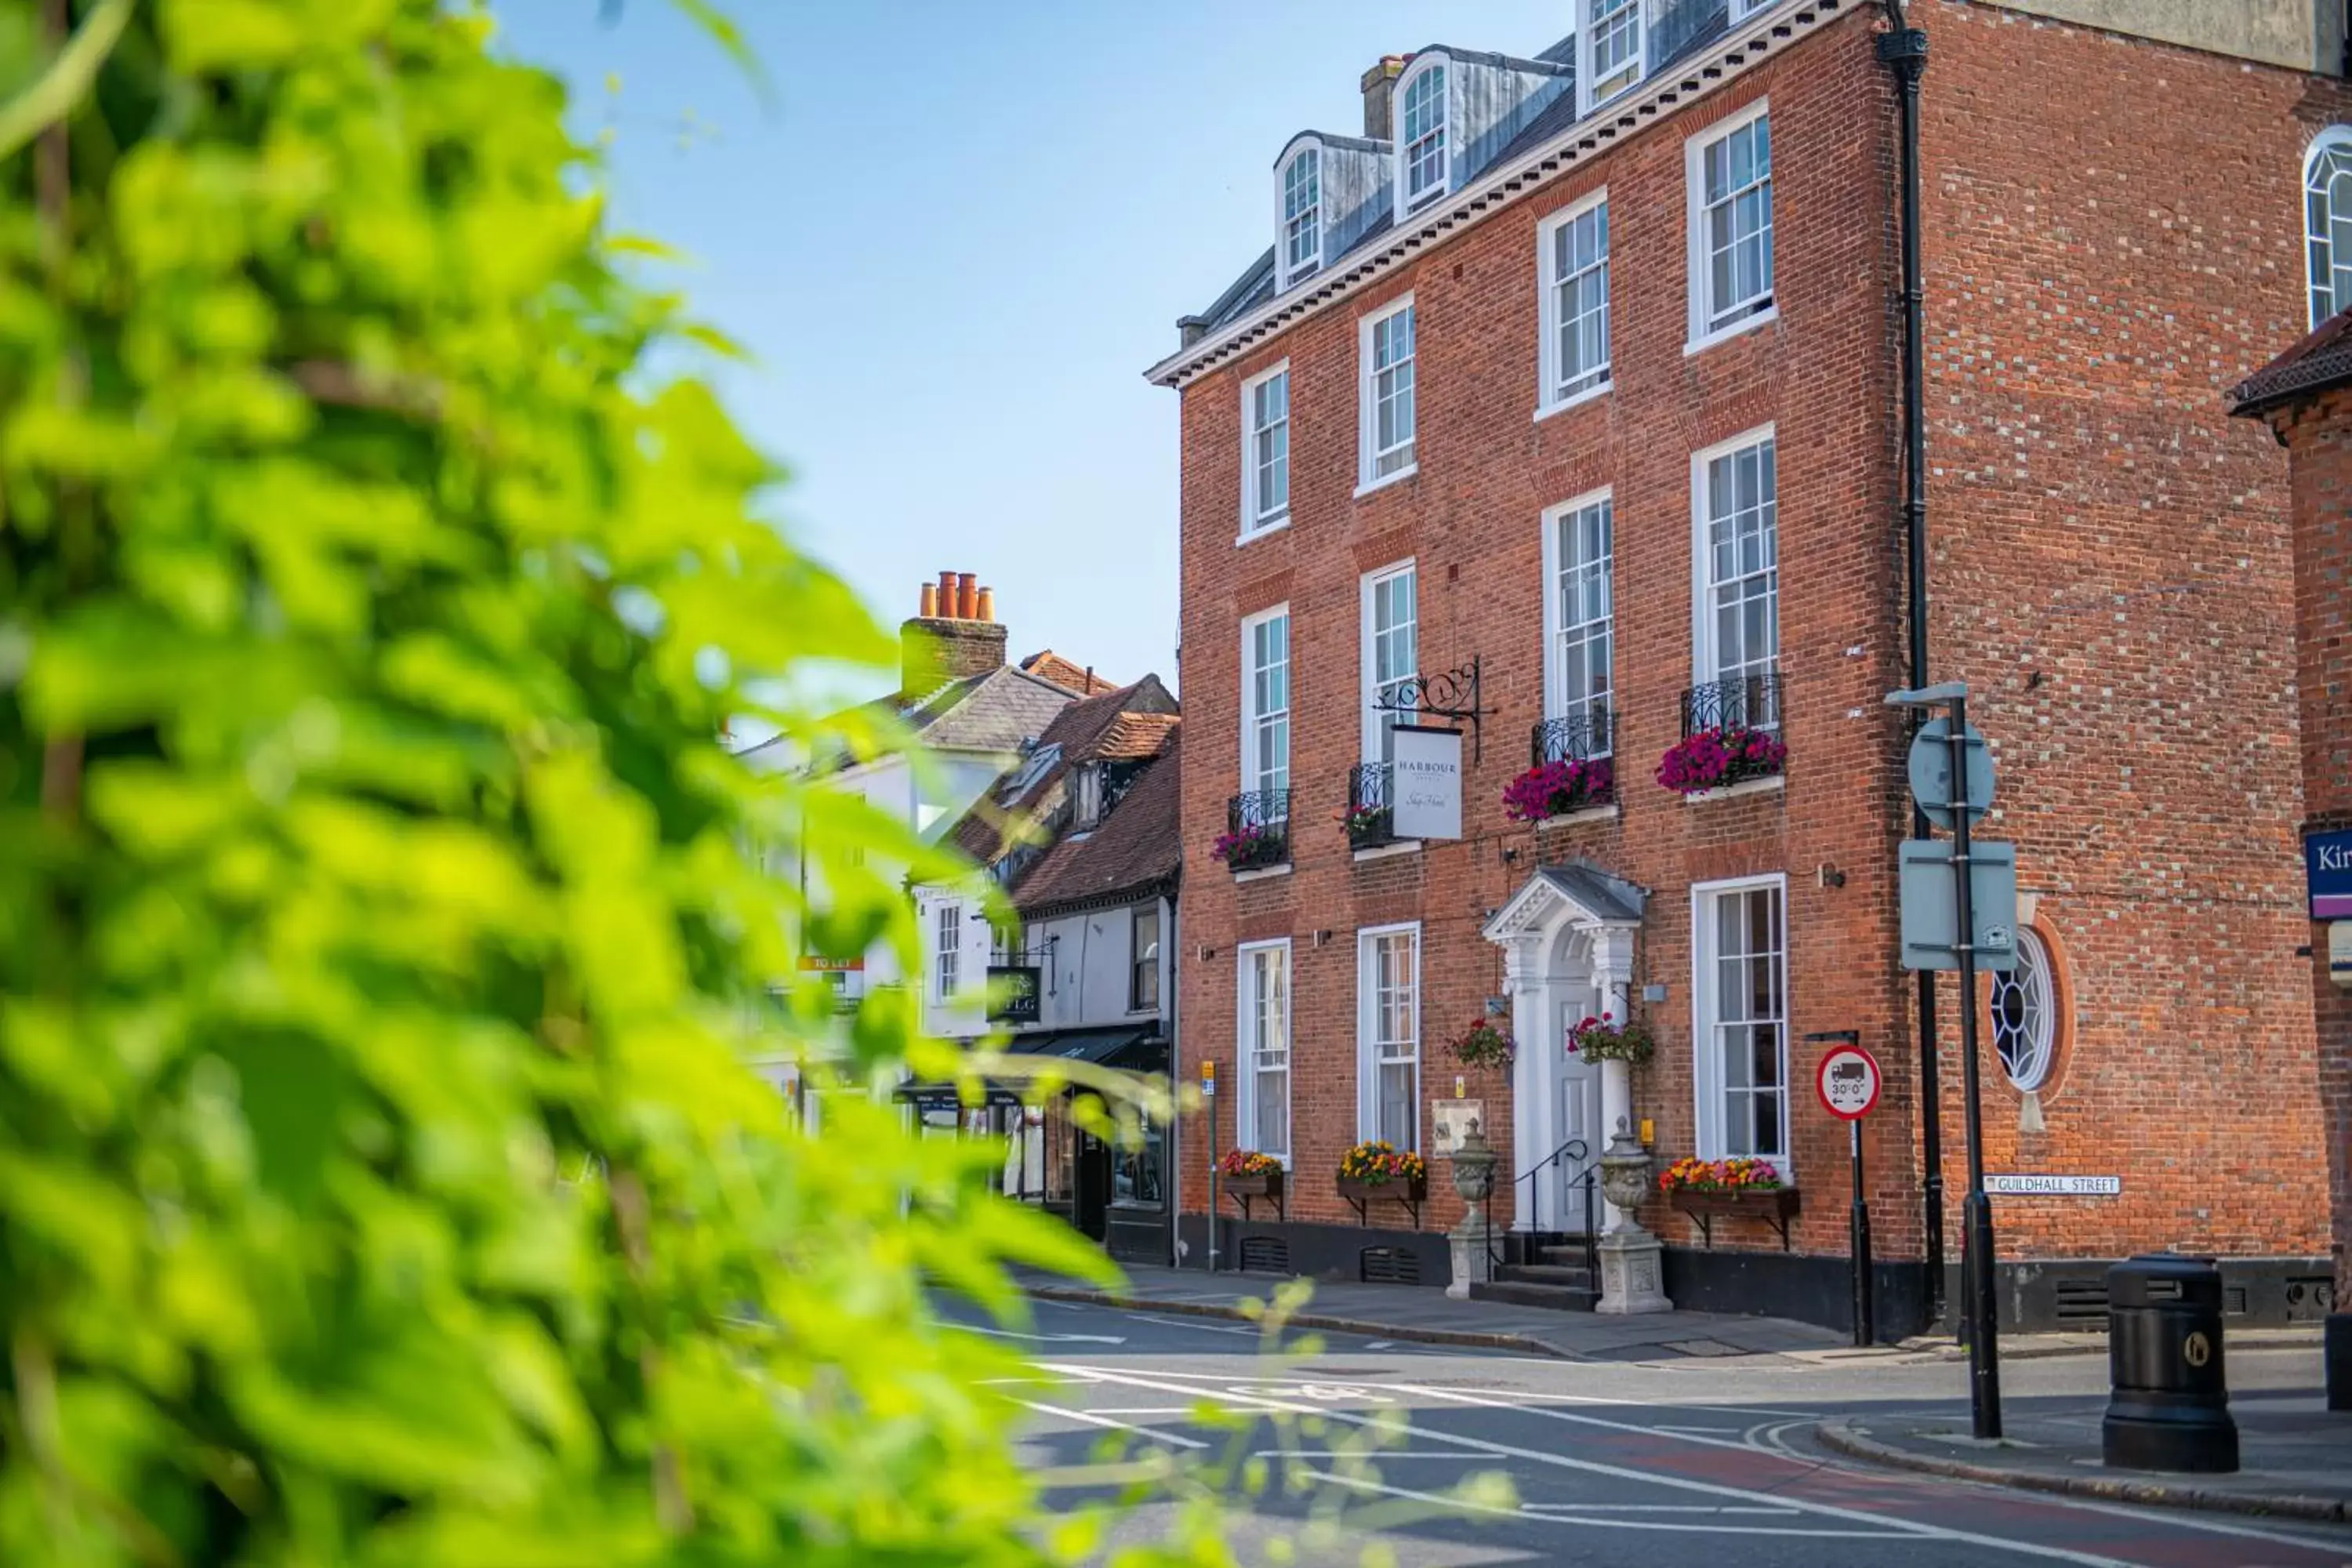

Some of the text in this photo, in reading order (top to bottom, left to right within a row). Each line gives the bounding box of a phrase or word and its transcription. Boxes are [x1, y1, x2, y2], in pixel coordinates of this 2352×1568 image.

[1399, 760, 1456, 774] HARBOUR
[1998, 1178, 2115, 1192] GUILDHALL STREET
